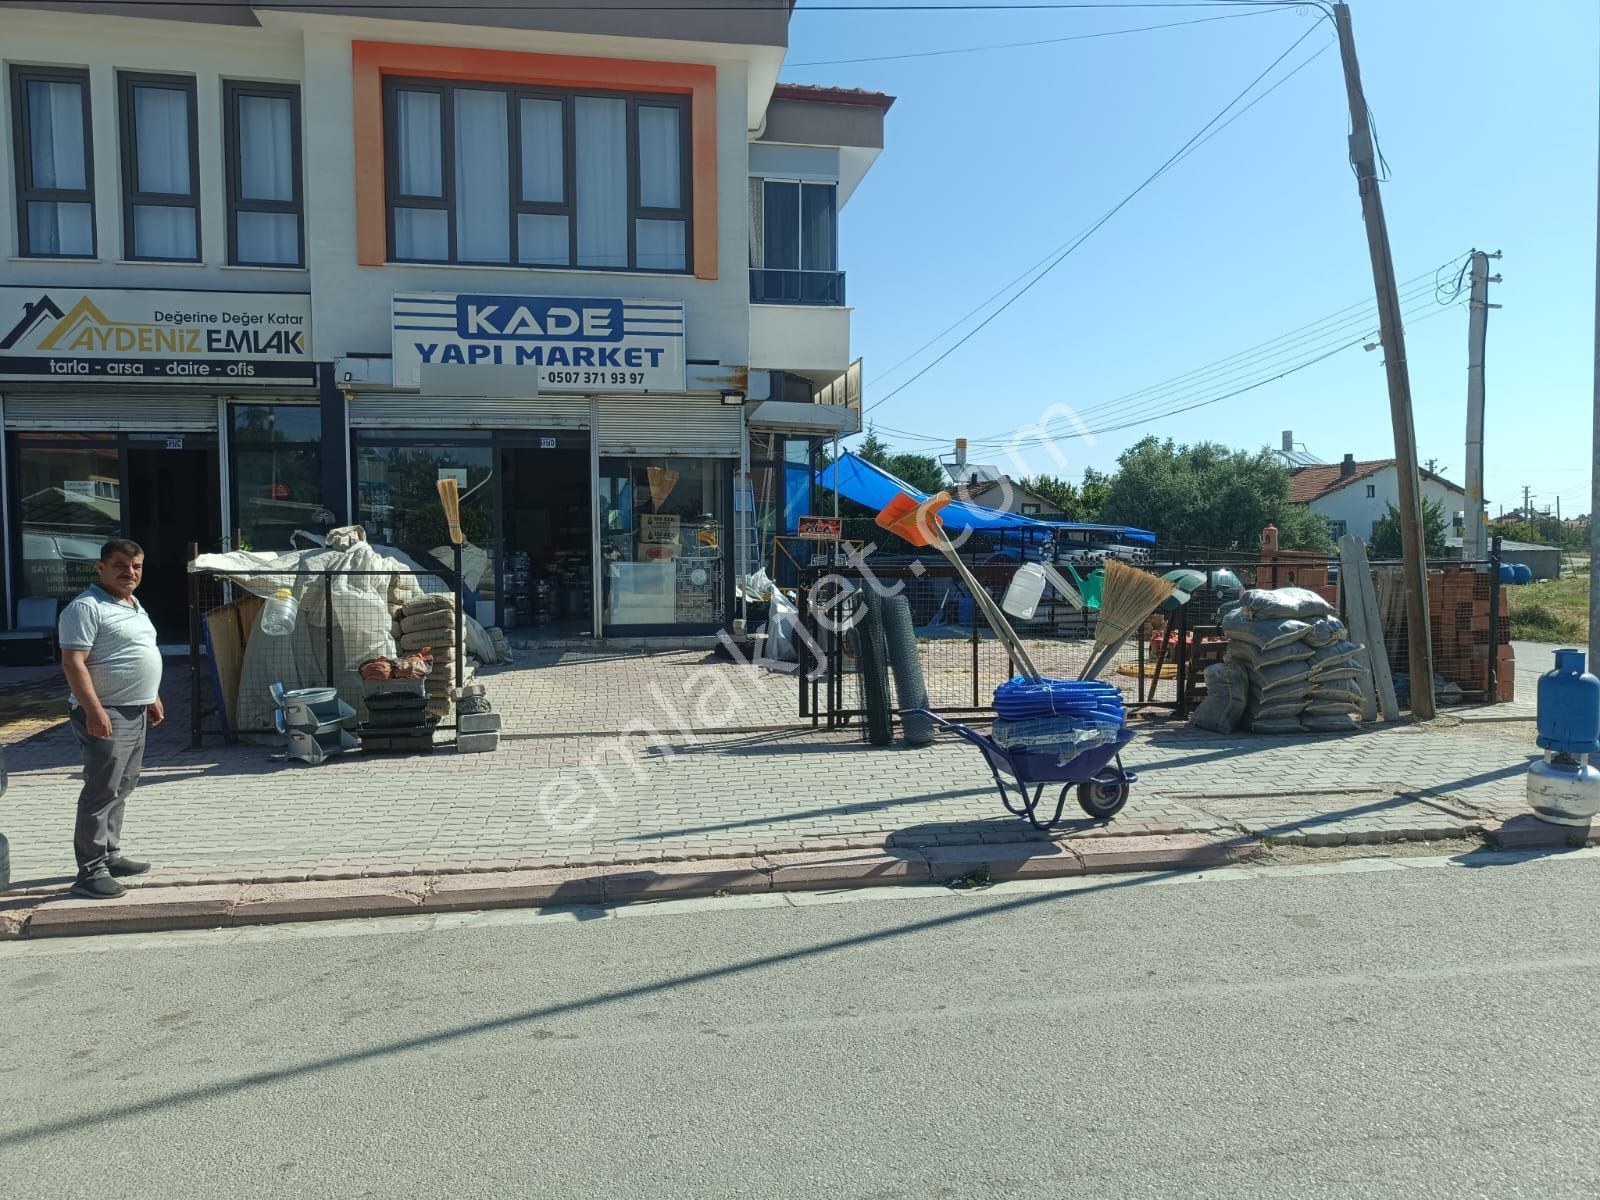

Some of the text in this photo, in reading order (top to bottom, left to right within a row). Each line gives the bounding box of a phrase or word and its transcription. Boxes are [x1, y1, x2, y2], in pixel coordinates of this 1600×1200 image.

[154, 311, 304, 327] Değerine Değer Katar
[467, 304, 612, 336] KADE
[206, 330, 304, 354] EMLAK
[414, 343, 664, 368] YAPI MARKET
[49, 360, 89, 374] tarla
[107, 364, 144, 375] arsa
[166, 362, 210, 376] daire
[226, 363, 255, 376] ofis
[548, 372, 580, 384] 0507
[583, 373, 607, 385] 371
[610, 373, 626, 385] 93
[629, 373, 645, 385] 97
